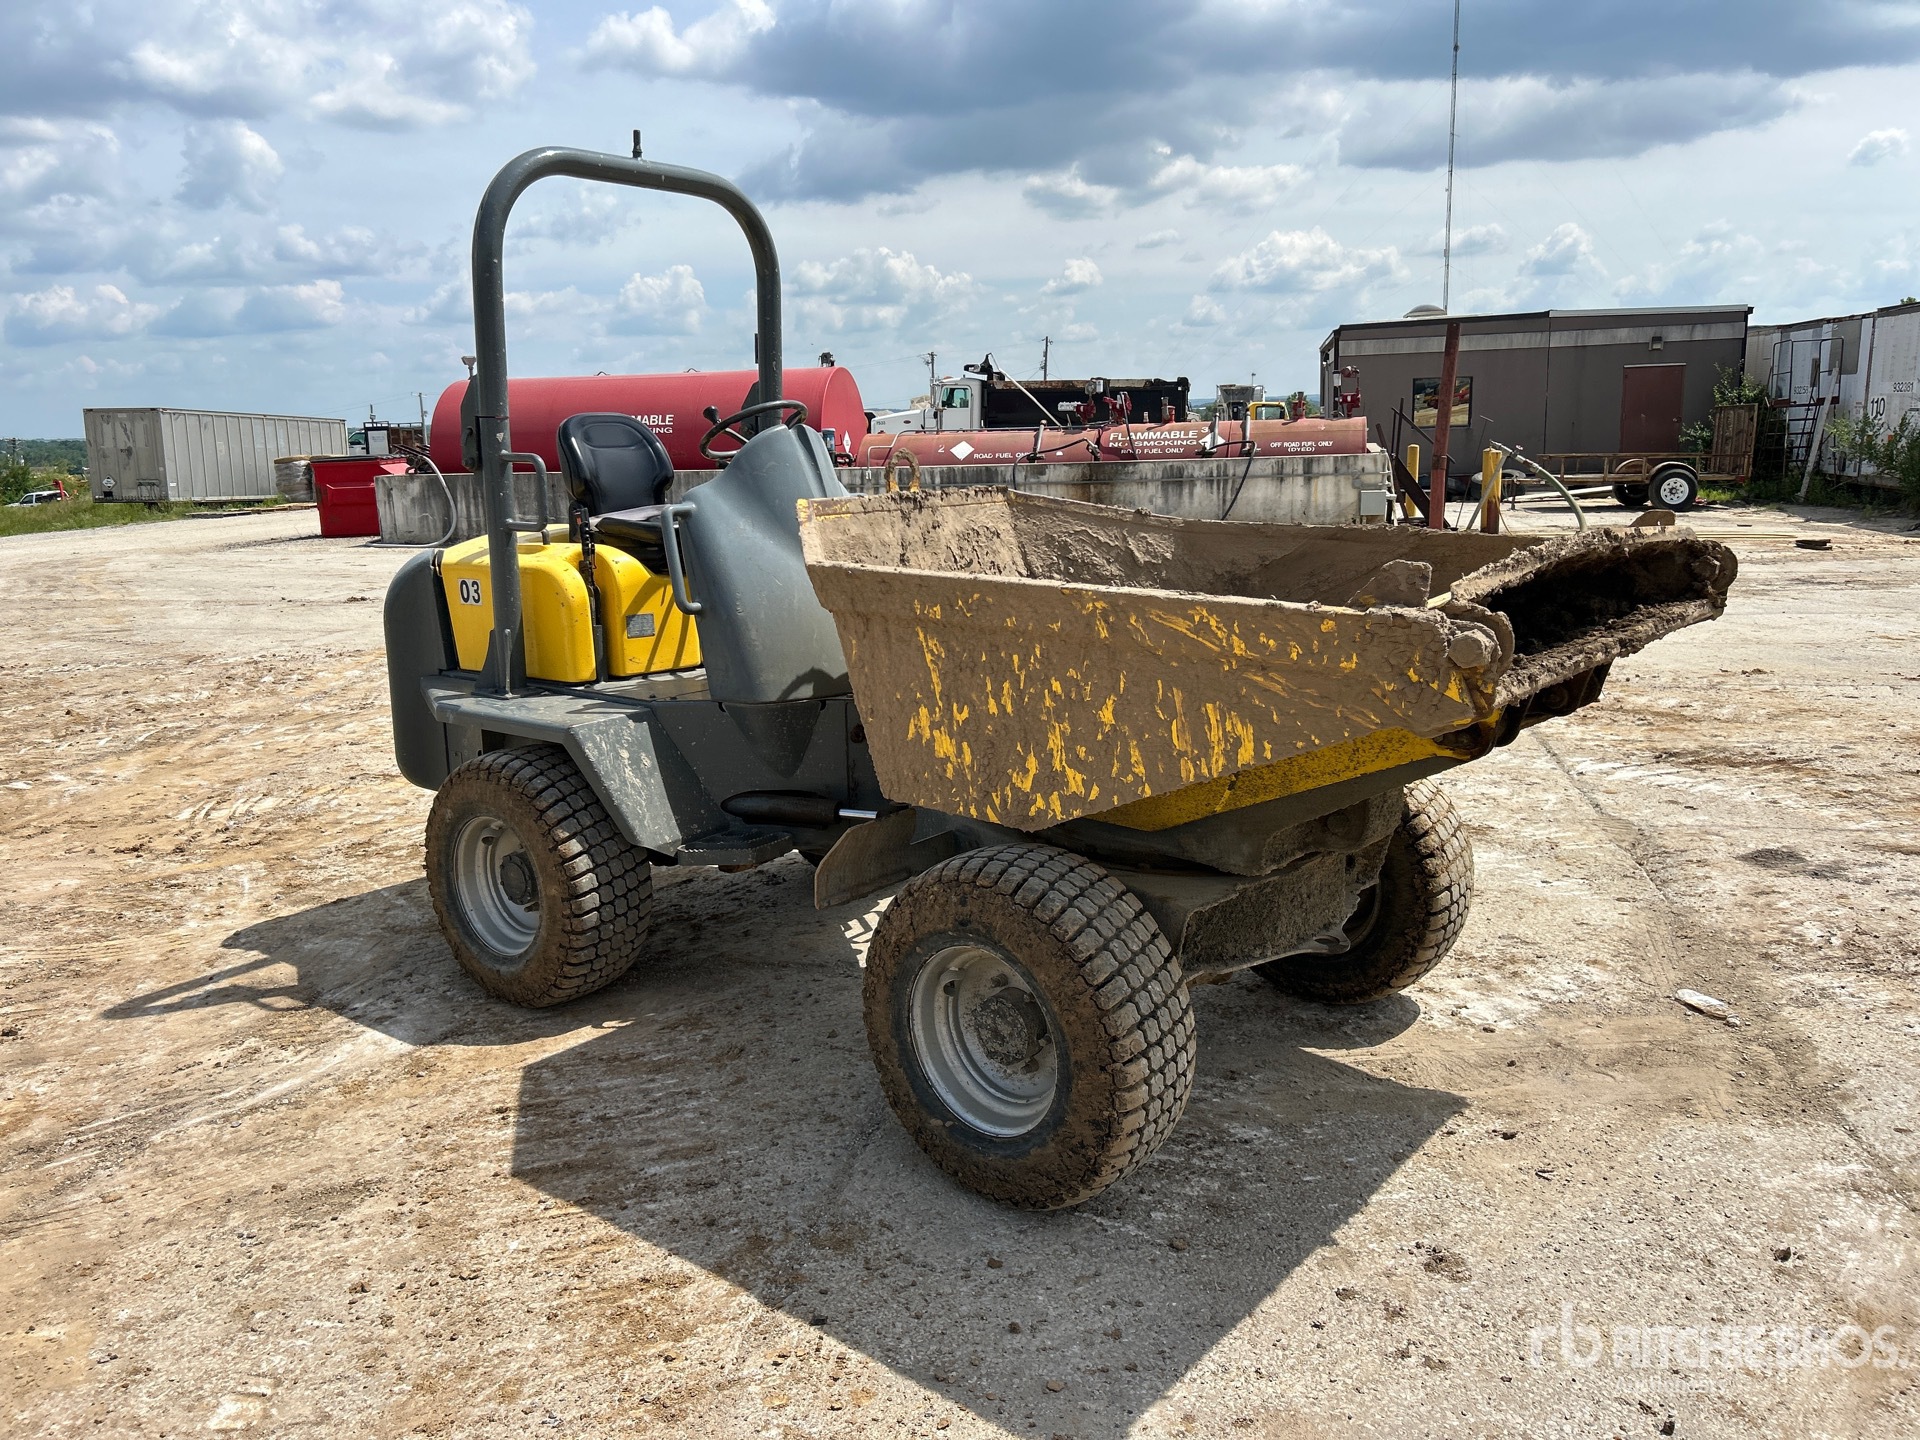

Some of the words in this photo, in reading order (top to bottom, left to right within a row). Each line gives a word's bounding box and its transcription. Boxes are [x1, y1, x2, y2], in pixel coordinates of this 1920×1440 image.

[1870, 397, 1886, 418] 110
[1109, 430, 1199, 441] FLAMMABLE
[937, 444, 945, 453] 2
[459, 579, 481, 604] 03
